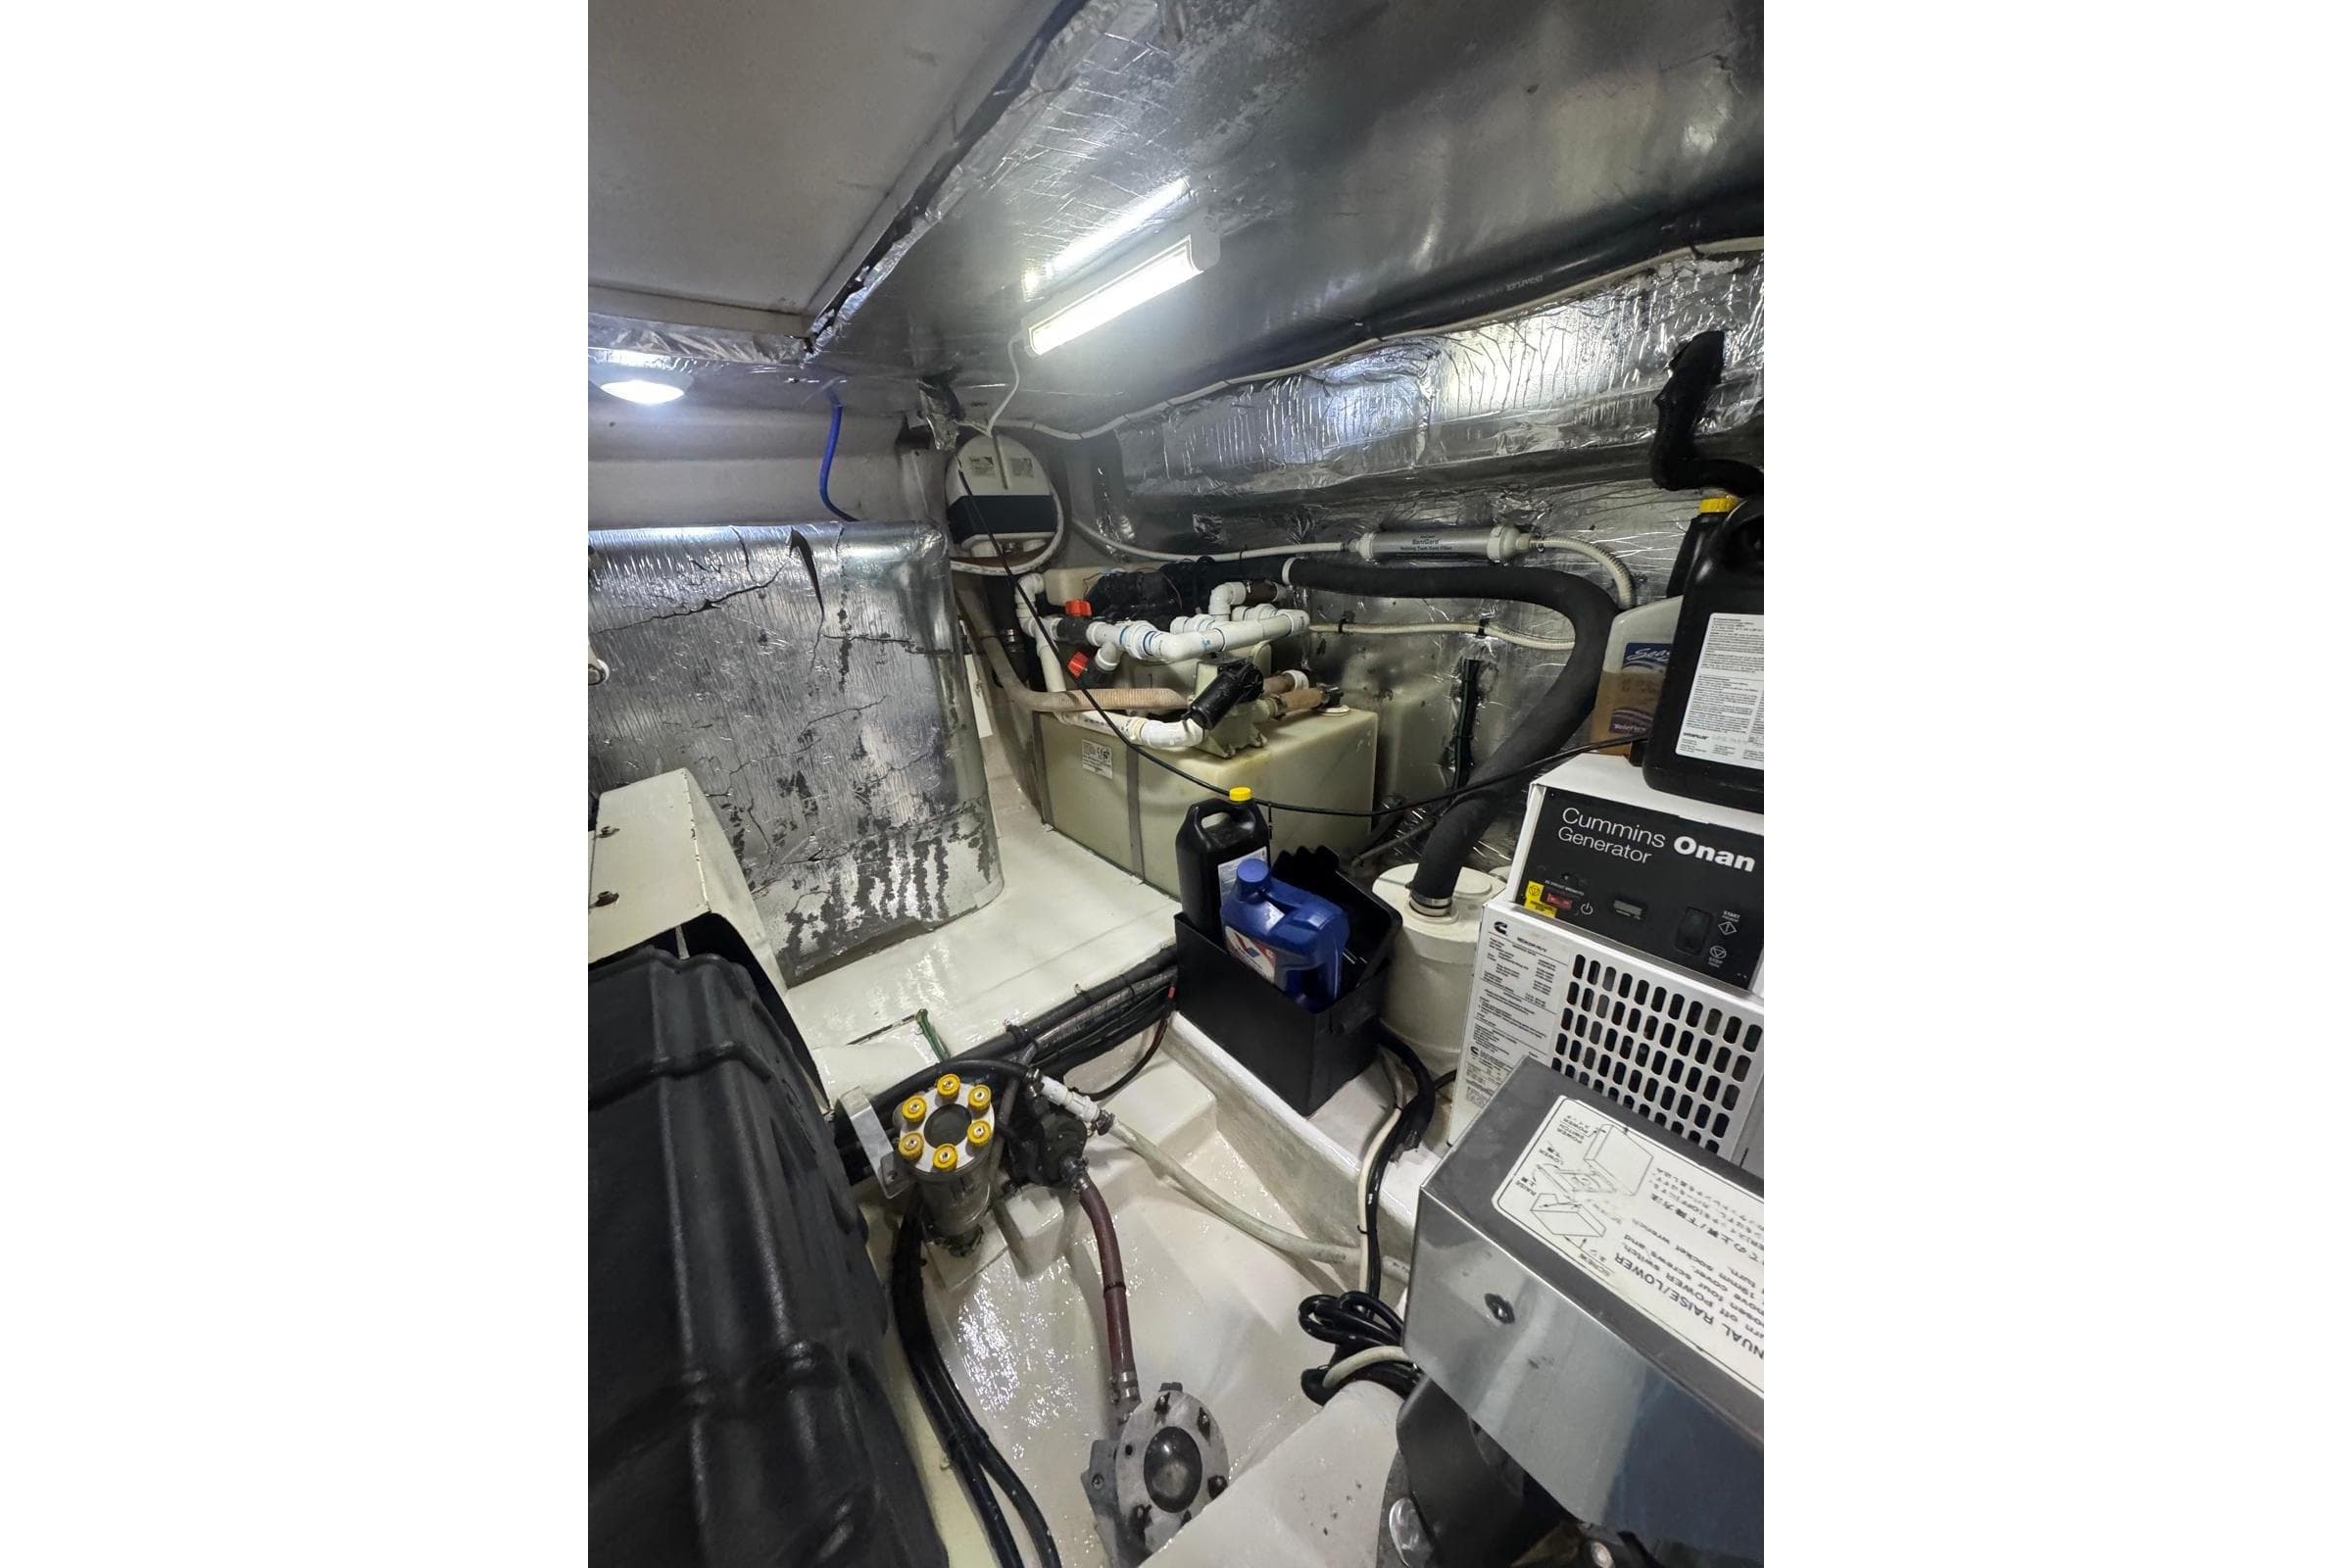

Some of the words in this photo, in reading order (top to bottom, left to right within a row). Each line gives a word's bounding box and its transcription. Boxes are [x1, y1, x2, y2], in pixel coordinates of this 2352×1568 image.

[1558, 826, 1652, 863] Generator
[1562, 808, 1666, 848] Cummins
[1673, 836, 1756, 872] Onan
[1624, 1234, 1645, 1250] and
[1632, 1218, 1670, 1244] wrench
[1651, 1250, 1691, 1280] screws
[1676, 1245, 1713, 1271] socket
[1615, 1252, 1714, 1325] RAISE/LOWER
[1666, 1272, 1713, 1307] POWER
[1698, 1283, 1724, 1302] four
[1720, 1308, 1738, 1322] off
[1730, 1302, 1764, 1327] osen
